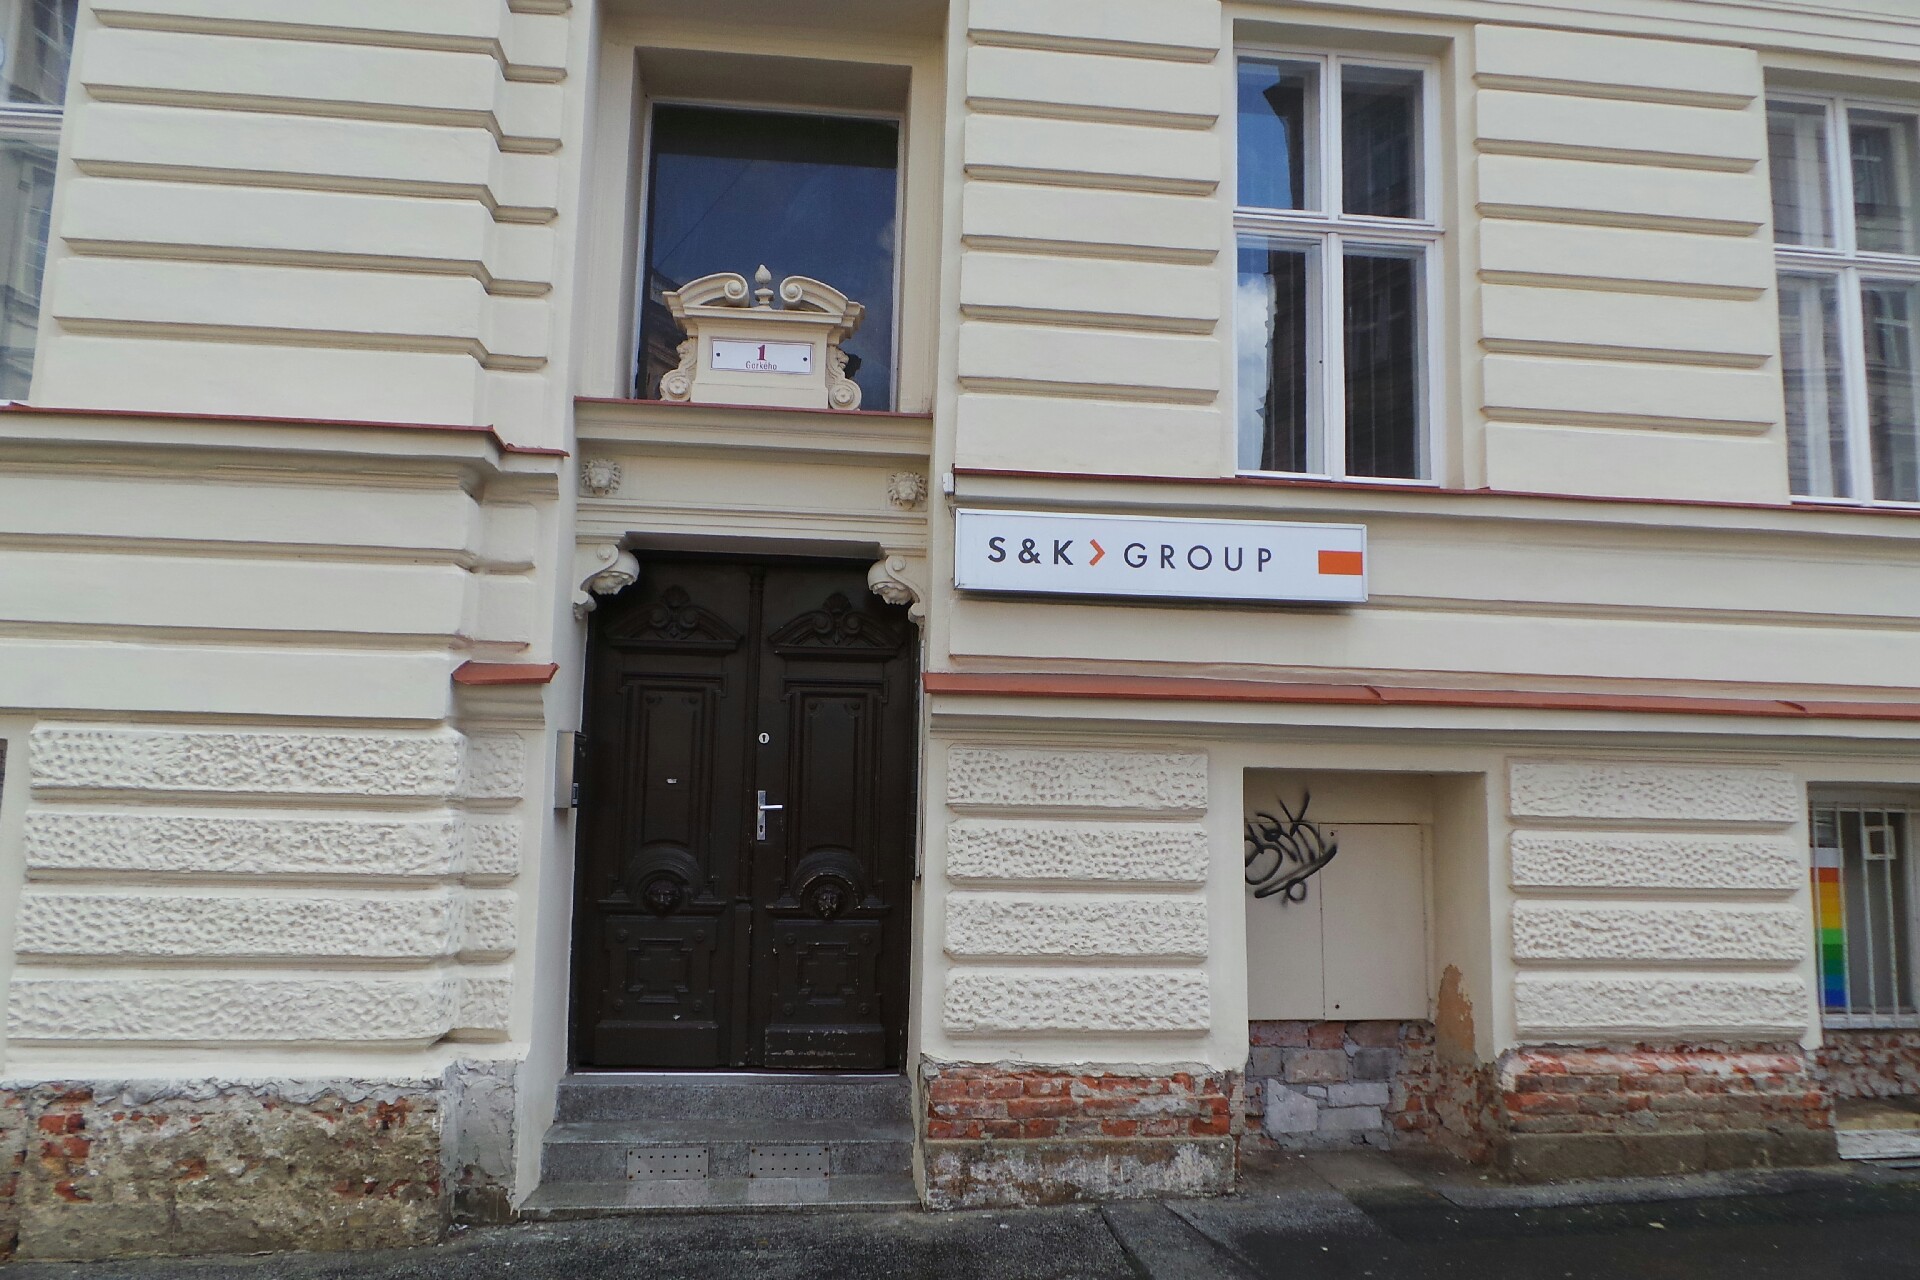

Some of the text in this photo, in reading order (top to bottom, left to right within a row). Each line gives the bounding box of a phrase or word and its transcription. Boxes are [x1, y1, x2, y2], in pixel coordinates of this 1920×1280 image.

[757, 344, 766, 361] 1
[987, 536, 1272, 573] S&K GROUP
